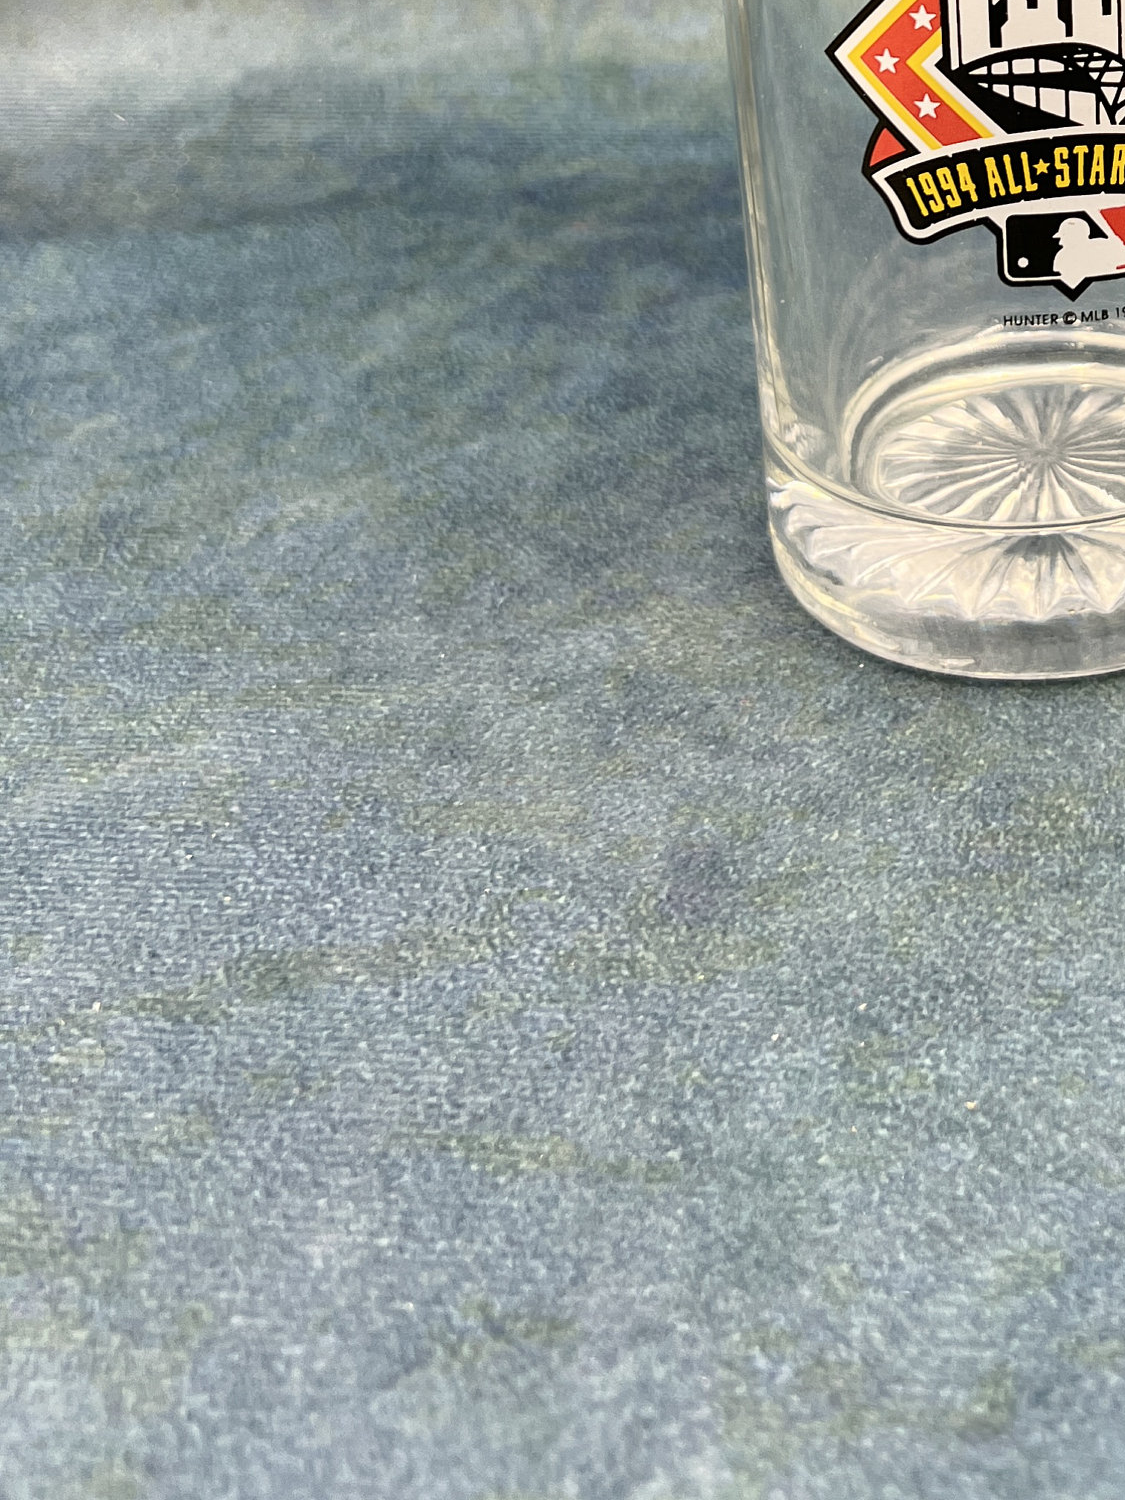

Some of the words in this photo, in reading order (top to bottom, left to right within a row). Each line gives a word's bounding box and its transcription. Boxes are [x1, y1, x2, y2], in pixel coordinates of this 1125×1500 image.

[906, 162, 977, 217] 1994
[1003, 313, 1059, 327] HUNTER
[1080, 308, 1109, 323] MLB
